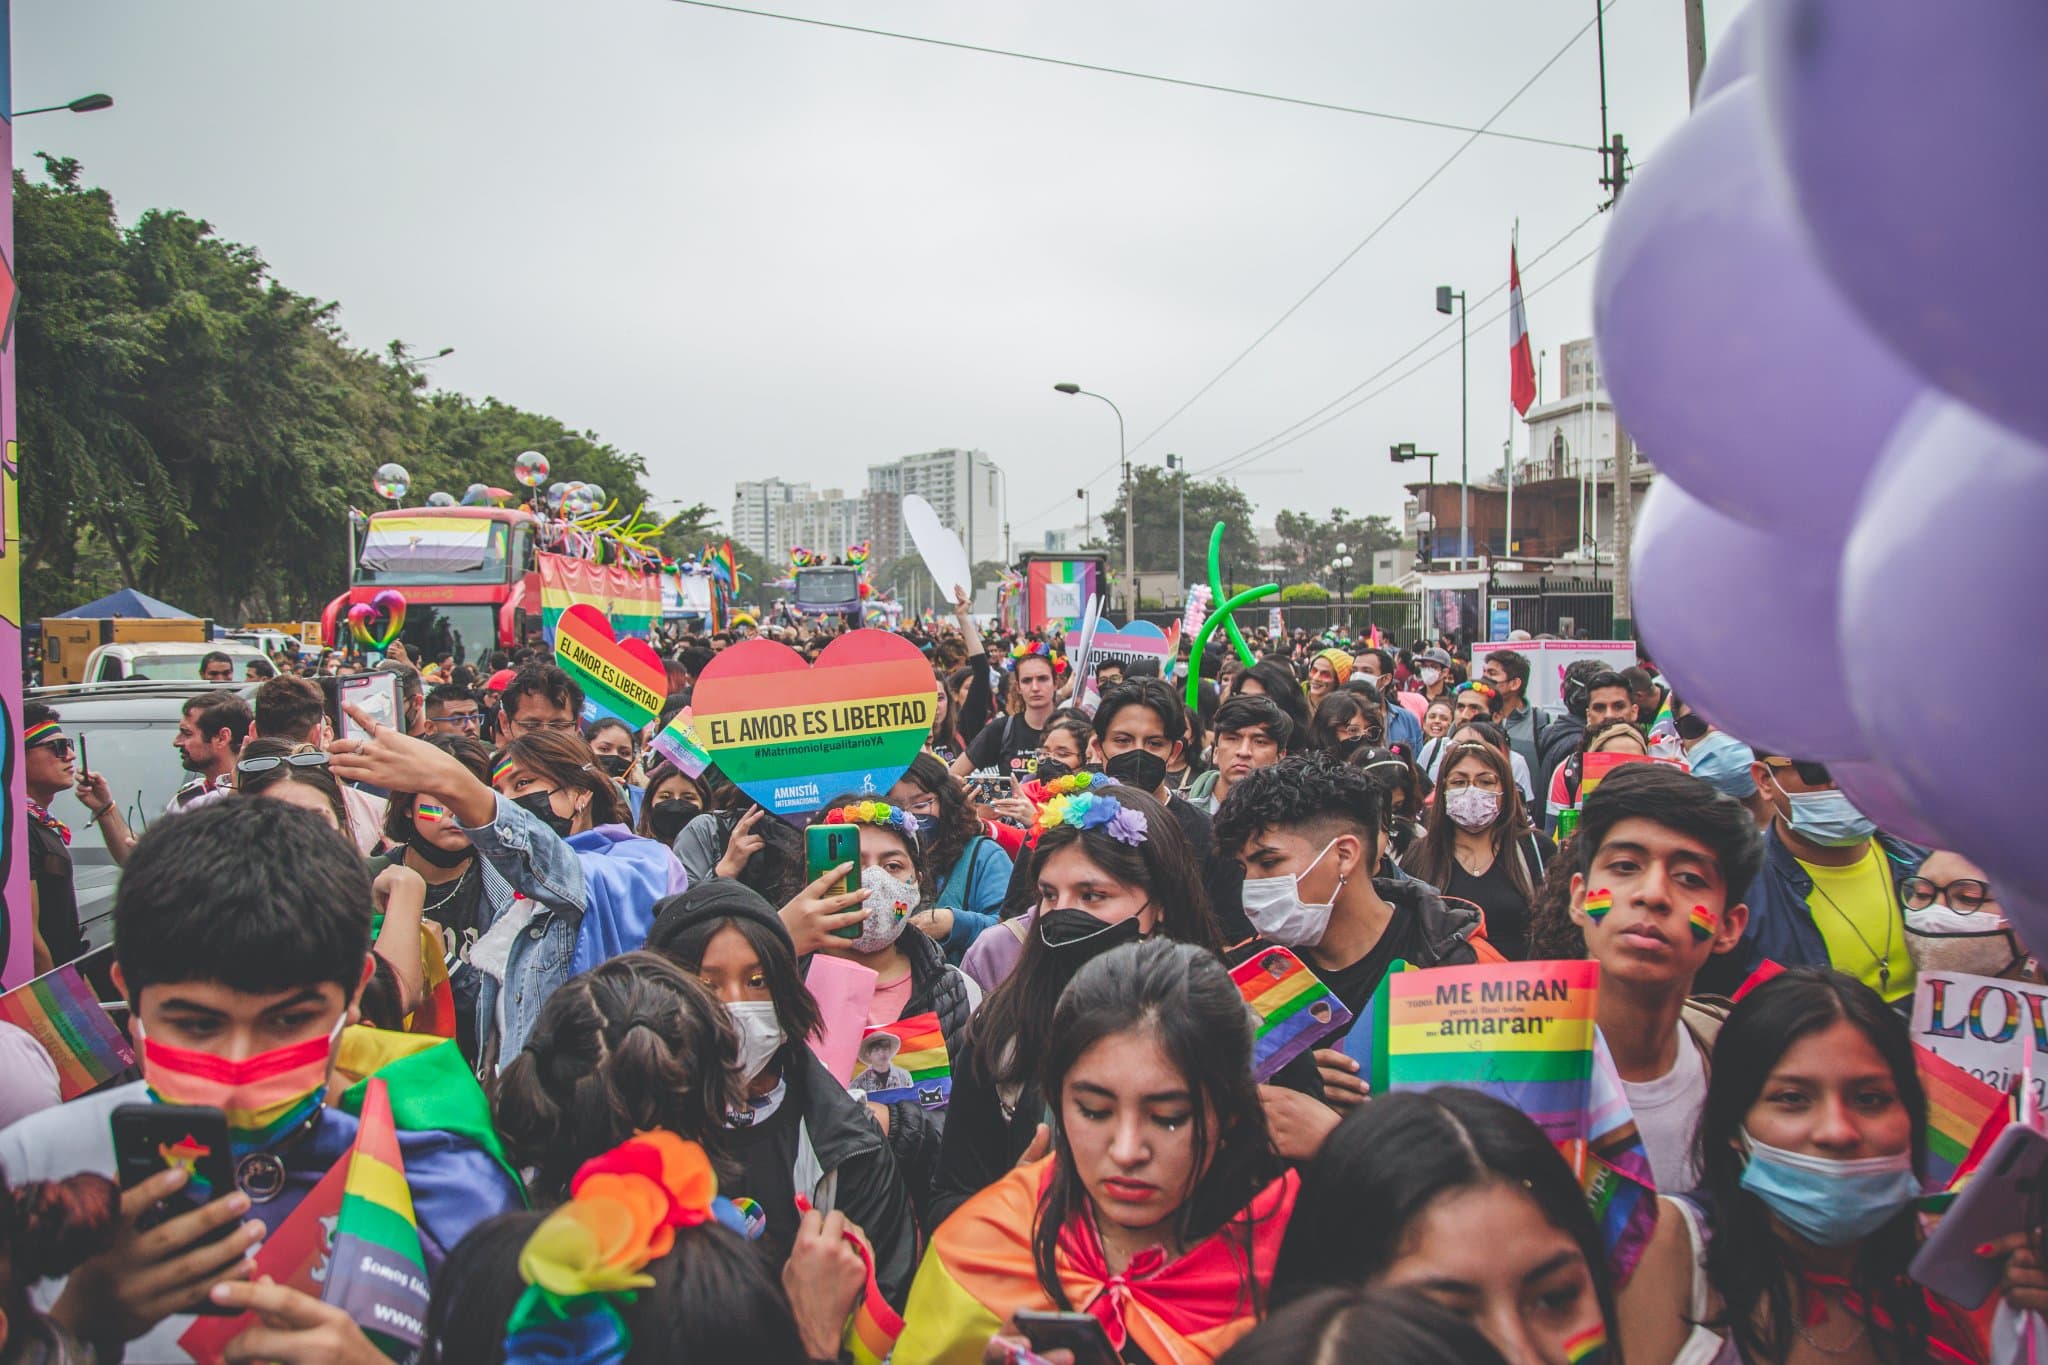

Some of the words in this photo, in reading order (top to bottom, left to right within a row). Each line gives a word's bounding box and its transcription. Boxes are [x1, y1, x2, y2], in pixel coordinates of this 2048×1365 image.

[560, 637, 572, 656] EL
[573, 646, 601, 676] AMOR
[601, 665, 616, 683] ES
[615, 673, 659, 711] LIBERTAD
[710, 719, 735, 744] EL
[739, 713, 798, 742] AMOR
[802, 709, 828, 735] ES
[832, 700, 927, 732] LIBERTAD
[754, 736, 884, 759] #MatrimonioIgualitarioYA
[774, 782, 819, 799] AMNISTÍA
[1436, 983, 1473, 1006] ME
[360, 1256, 408, 1287] Somos
